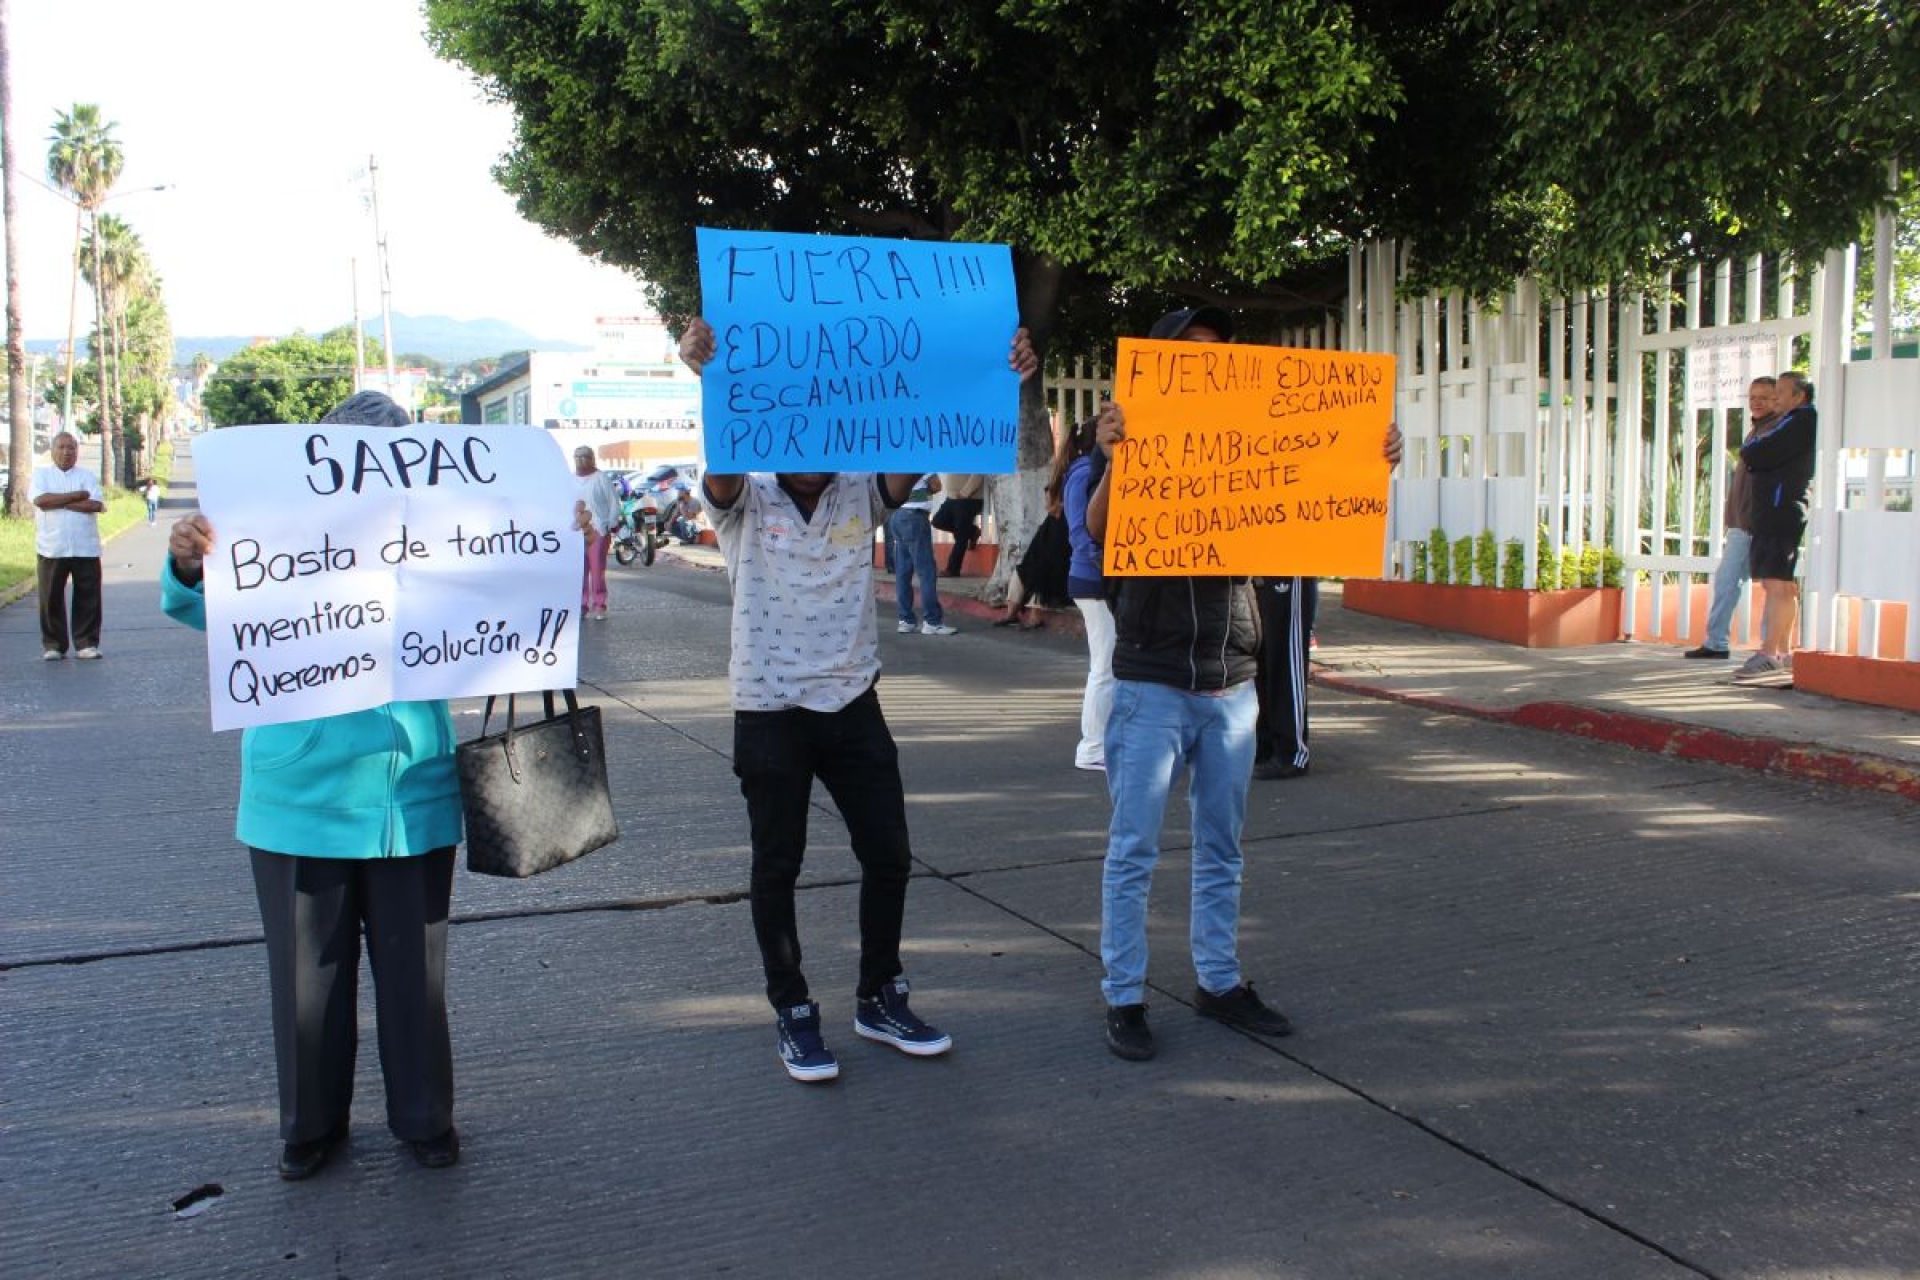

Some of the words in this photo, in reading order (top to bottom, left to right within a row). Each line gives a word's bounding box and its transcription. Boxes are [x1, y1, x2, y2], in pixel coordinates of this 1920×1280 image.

[725, 316, 921, 374] EDUARDO
[1128, 350, 1262, 398] FUERA!!!
[1276, 356, 1382, 389] EDUARDO
[720, 414, 809, 460] POR
[1118, 434, 1171, 474] POR
[304, 434, 497, 495] SAPAC
[231, 533, 356, 590] Basta
[380, 525, 430, 565] de
[447, 520, 562, 557] tantas
[1112, 514, 1147, 548] LOS
[1112, 549, 1138, 572] LA
[1145, 542, 1227, 569] CULPA.
[232, 600, 391, 651] mentiras.
[228, 652, 377, 706] Queremos
